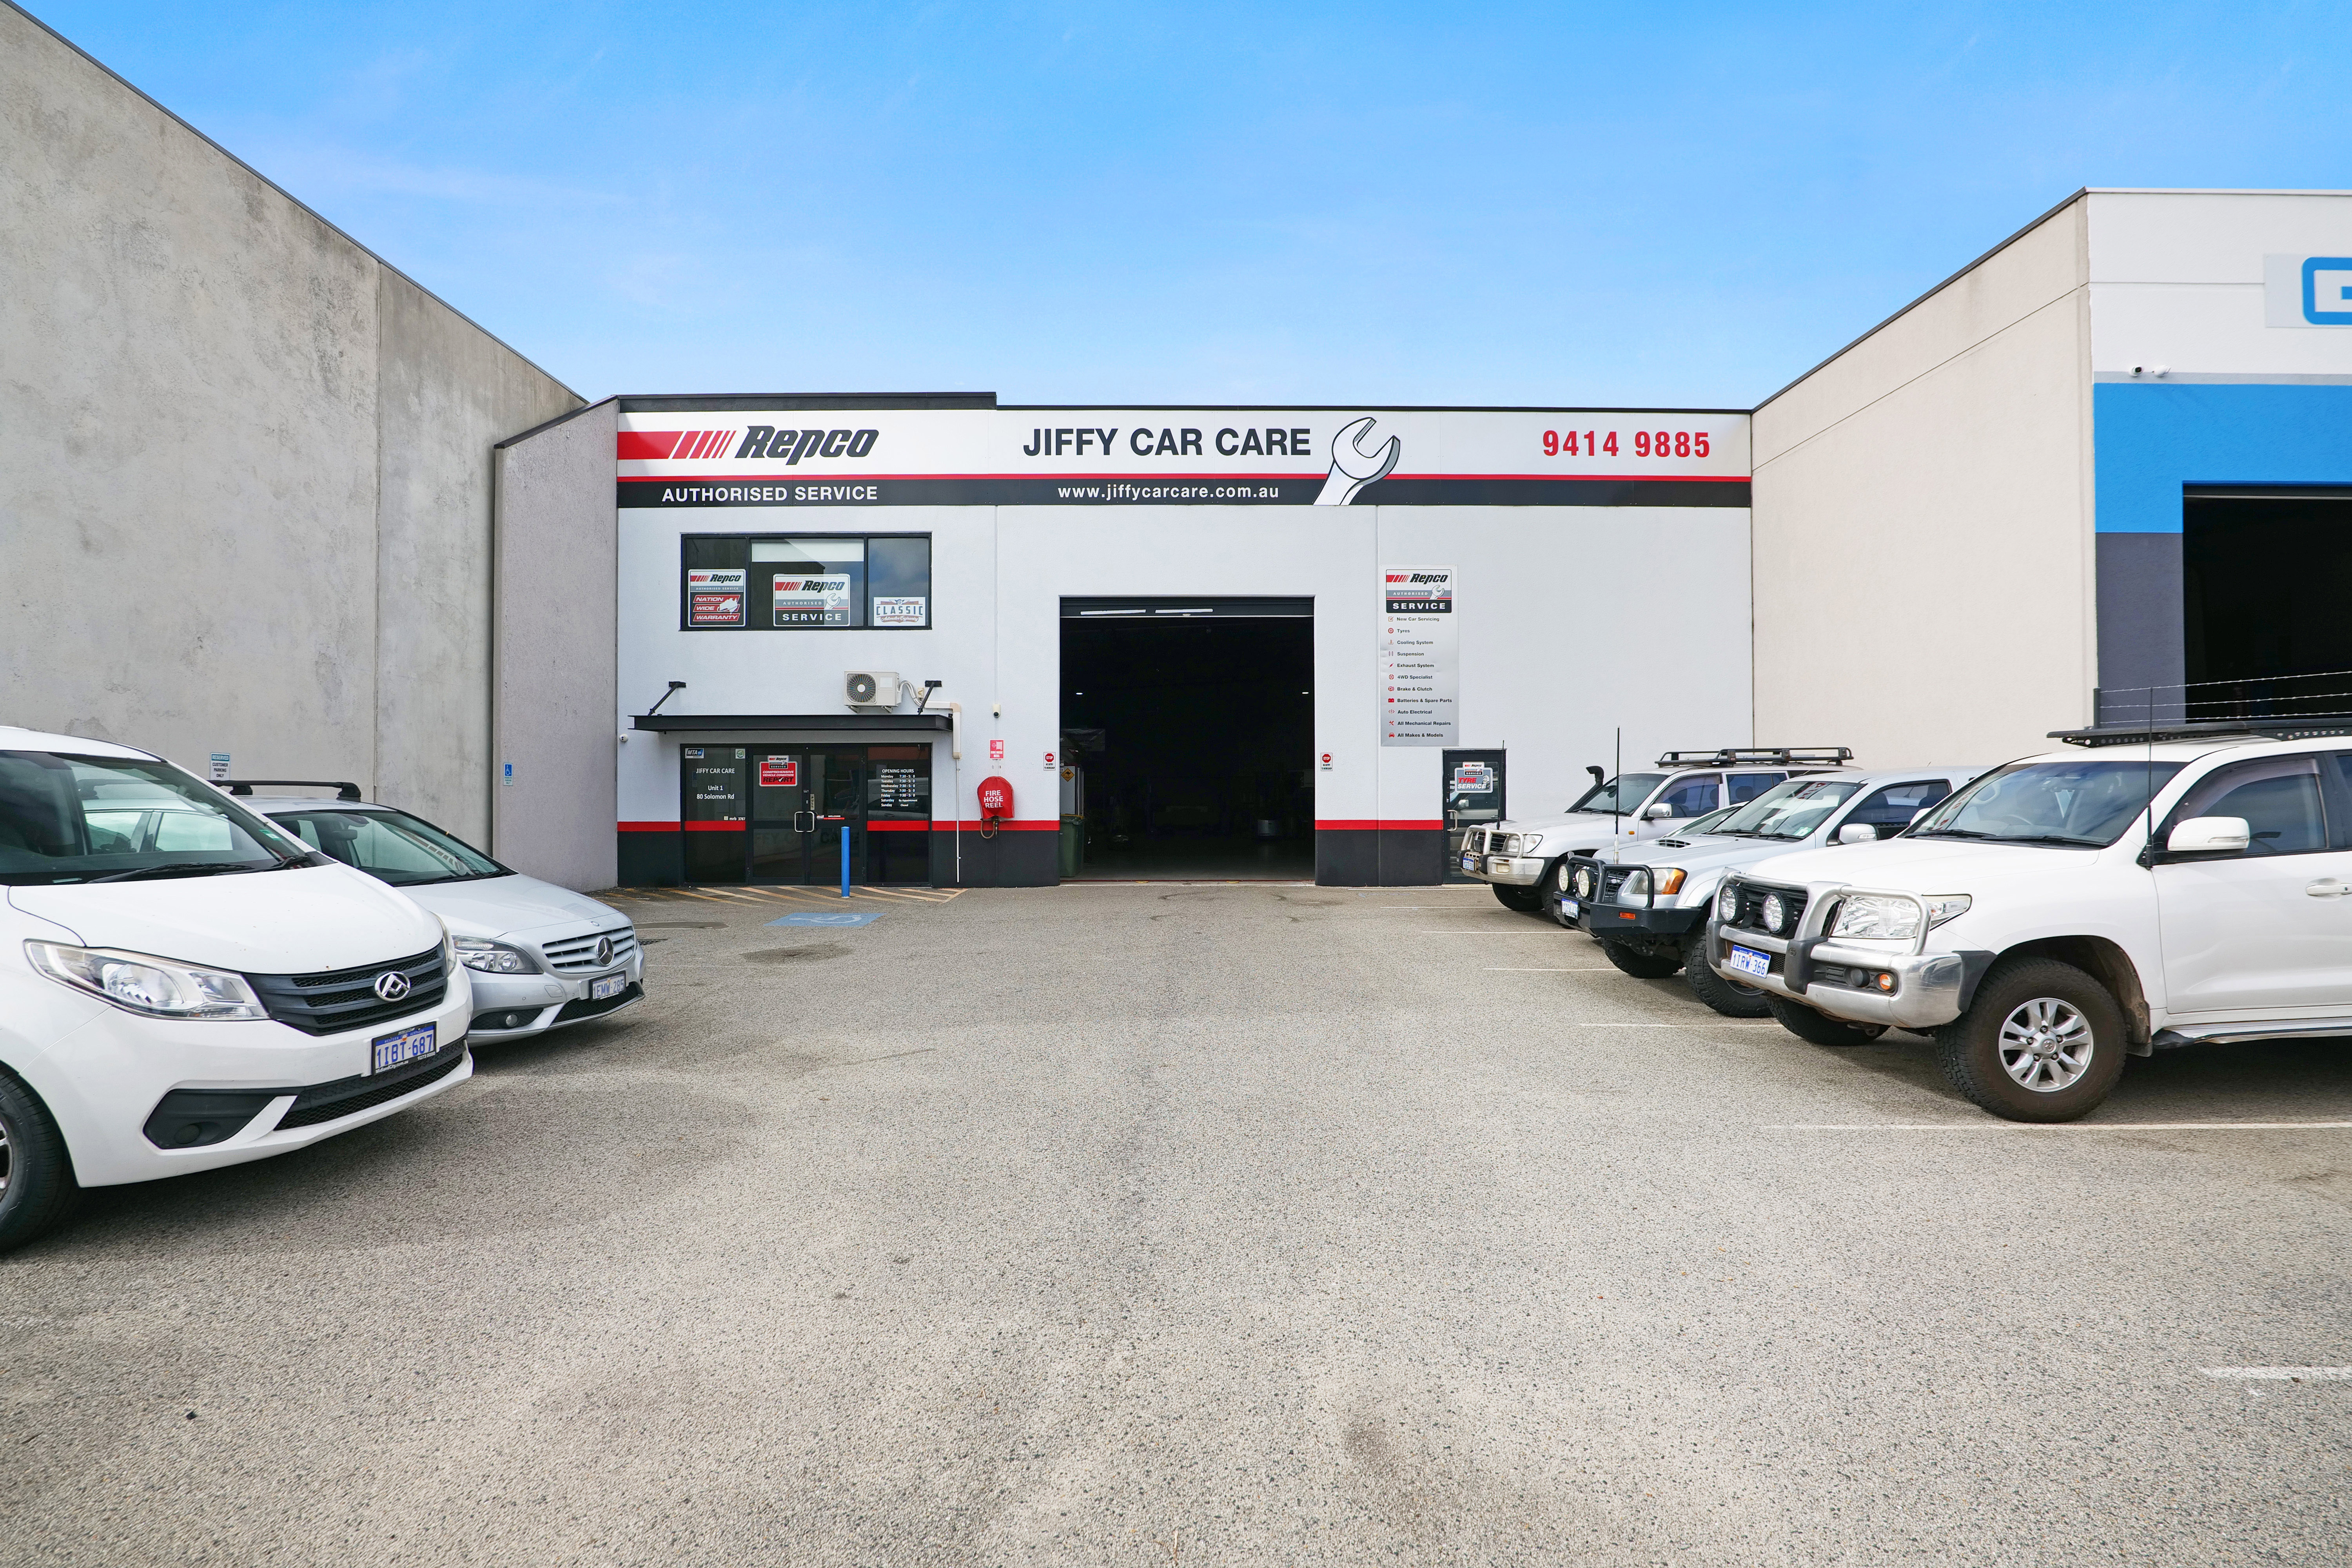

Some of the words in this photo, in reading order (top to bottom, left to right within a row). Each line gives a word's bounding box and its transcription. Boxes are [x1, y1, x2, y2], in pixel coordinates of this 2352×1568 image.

[735, 425, 879, 465] Repco
[1023, 428, 1118, 456] JIFFY
[1130, 428, 1203, 456] CAR
[1215, 428, 1311, 456] CARE
[1543, 430, 1619, 457] 9414
[1635, 431, 1710, 458] 9885
[662, 487, 787, 502] AUTHORISED
[795, 486, 878, 501] SERVICE
[1057, 484, 1279, 501] www.jiffycarcare.com.au
[710, 574, 741, 583] Repco
[801, 580, 845, 593] Repco
[1410, 573, 1448, 584] Repco
[876, 606, 923, 615] CLASSIC
